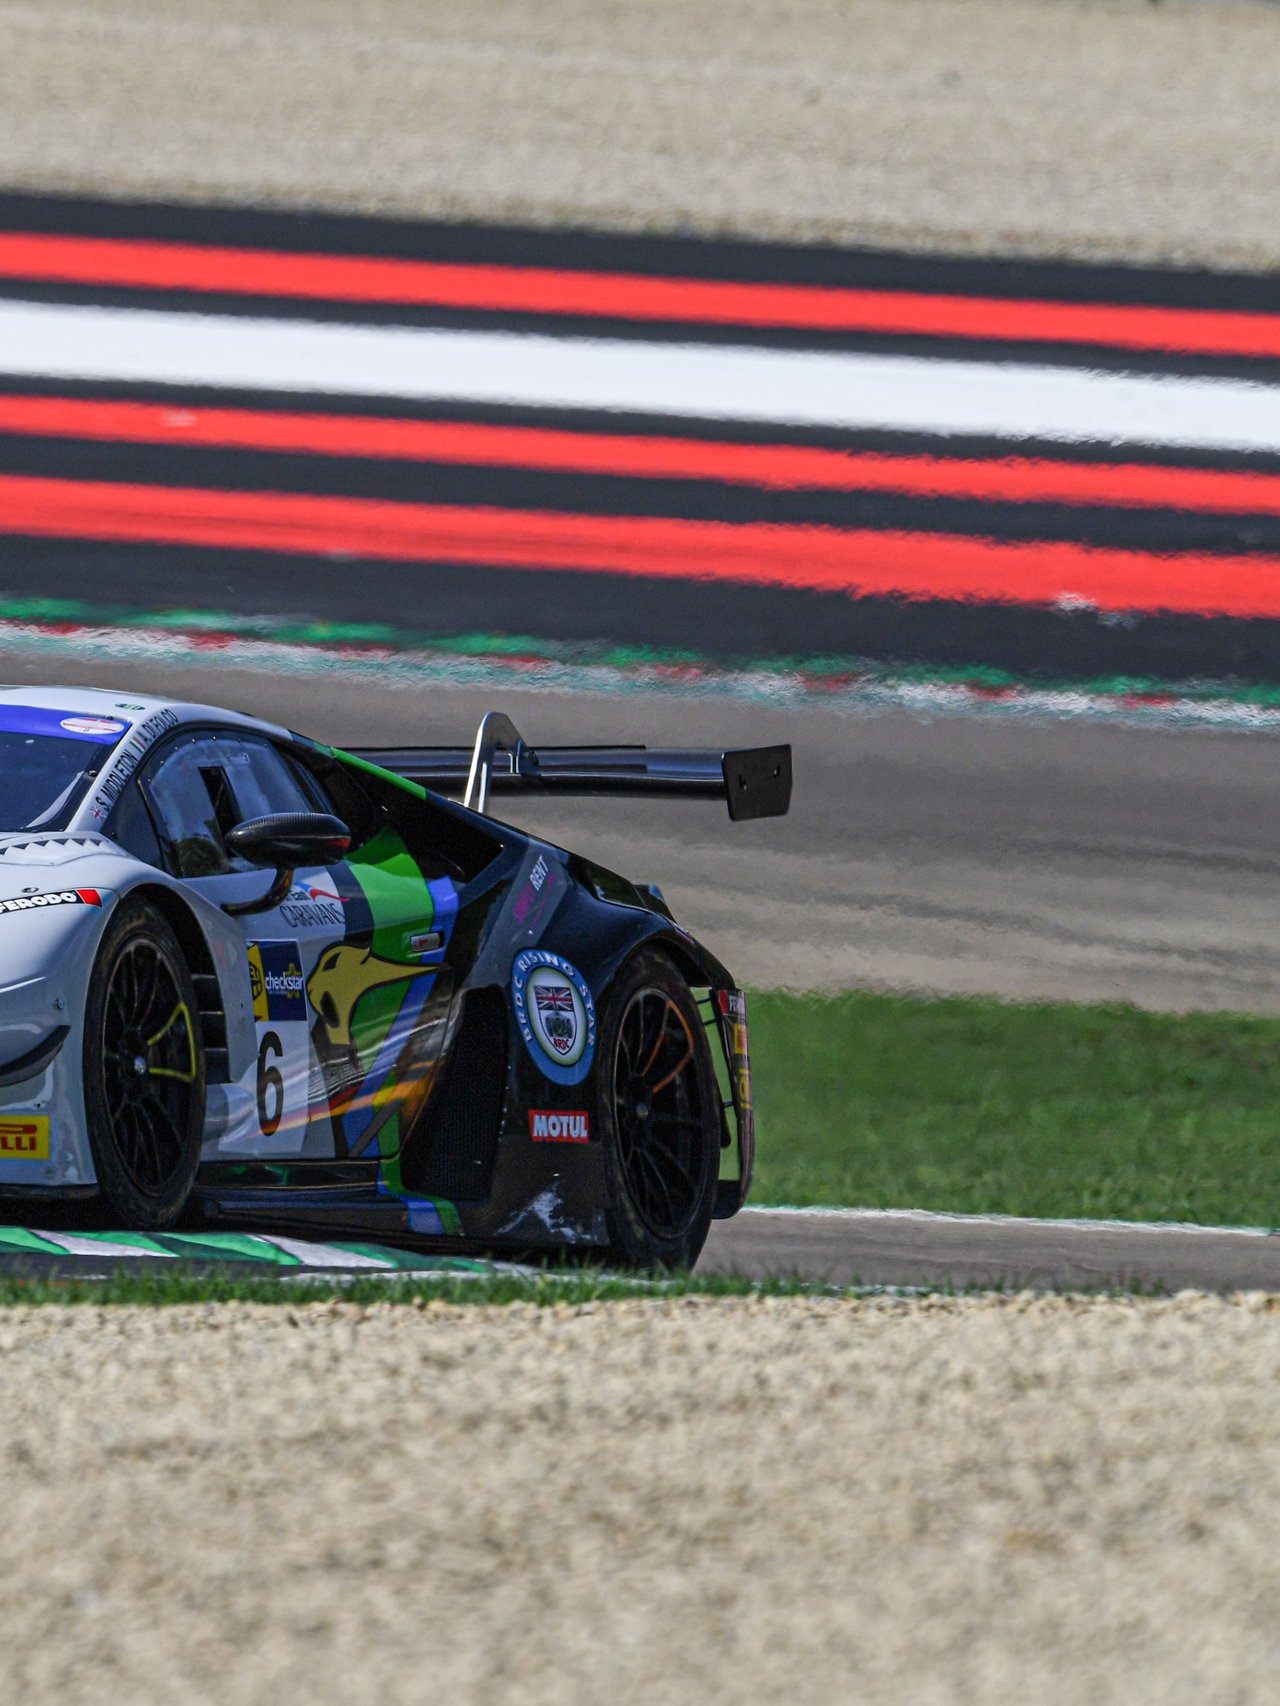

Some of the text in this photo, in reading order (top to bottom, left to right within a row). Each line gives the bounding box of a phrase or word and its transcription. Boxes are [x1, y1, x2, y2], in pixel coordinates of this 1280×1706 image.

[101, 749, 140, 802] MIDDLETON
[529, 855, 549, 891] RENT
[265, 971, 304, 990] checkstar
[519, 951, 574, 976] RISING
[580, 984, 595, 1046] STAR
[257, 1031, 284, 1136] 6
[533, 1115, 588, 1138] MOTUL
